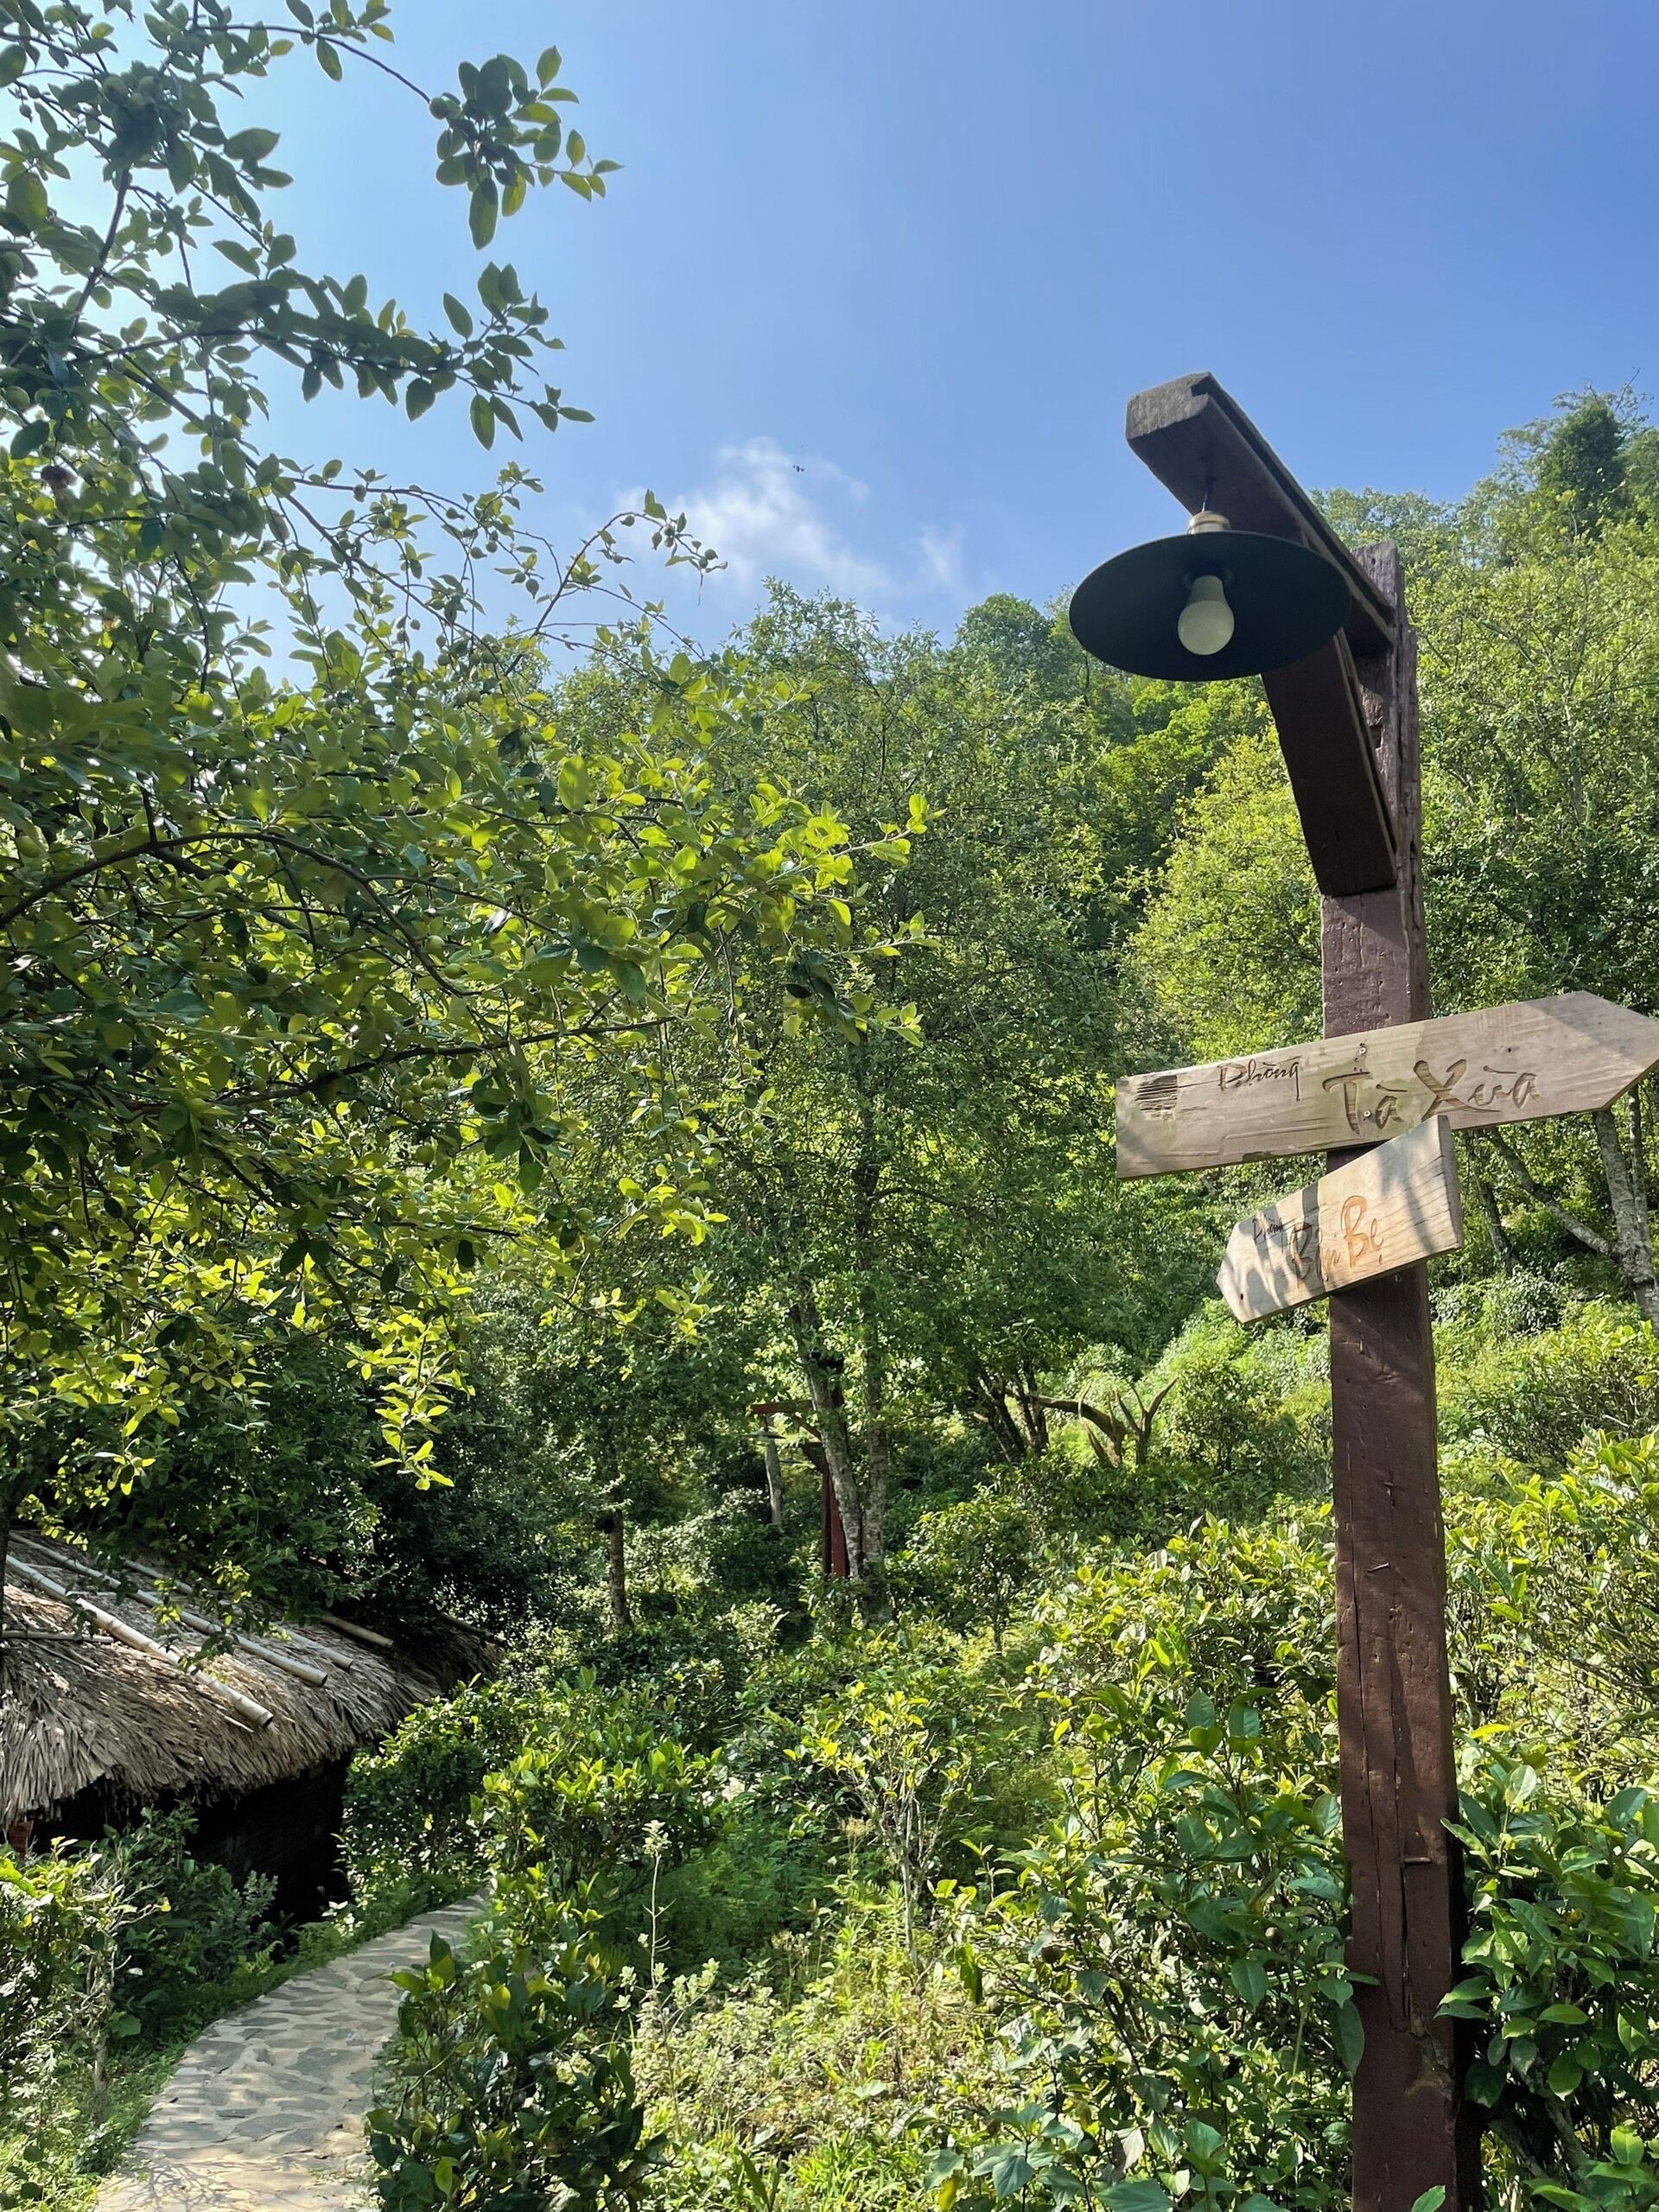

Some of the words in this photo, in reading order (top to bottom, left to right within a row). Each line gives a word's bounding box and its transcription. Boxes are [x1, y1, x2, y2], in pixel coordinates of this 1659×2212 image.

[1217, 1058, 1300, 1102] Phòng
[1322, 1071, 1408, 1135] Tà
[1412, 1058, 1544, 1122] Xùa
[1341, 1194, 1384, 1270] Bẹ
